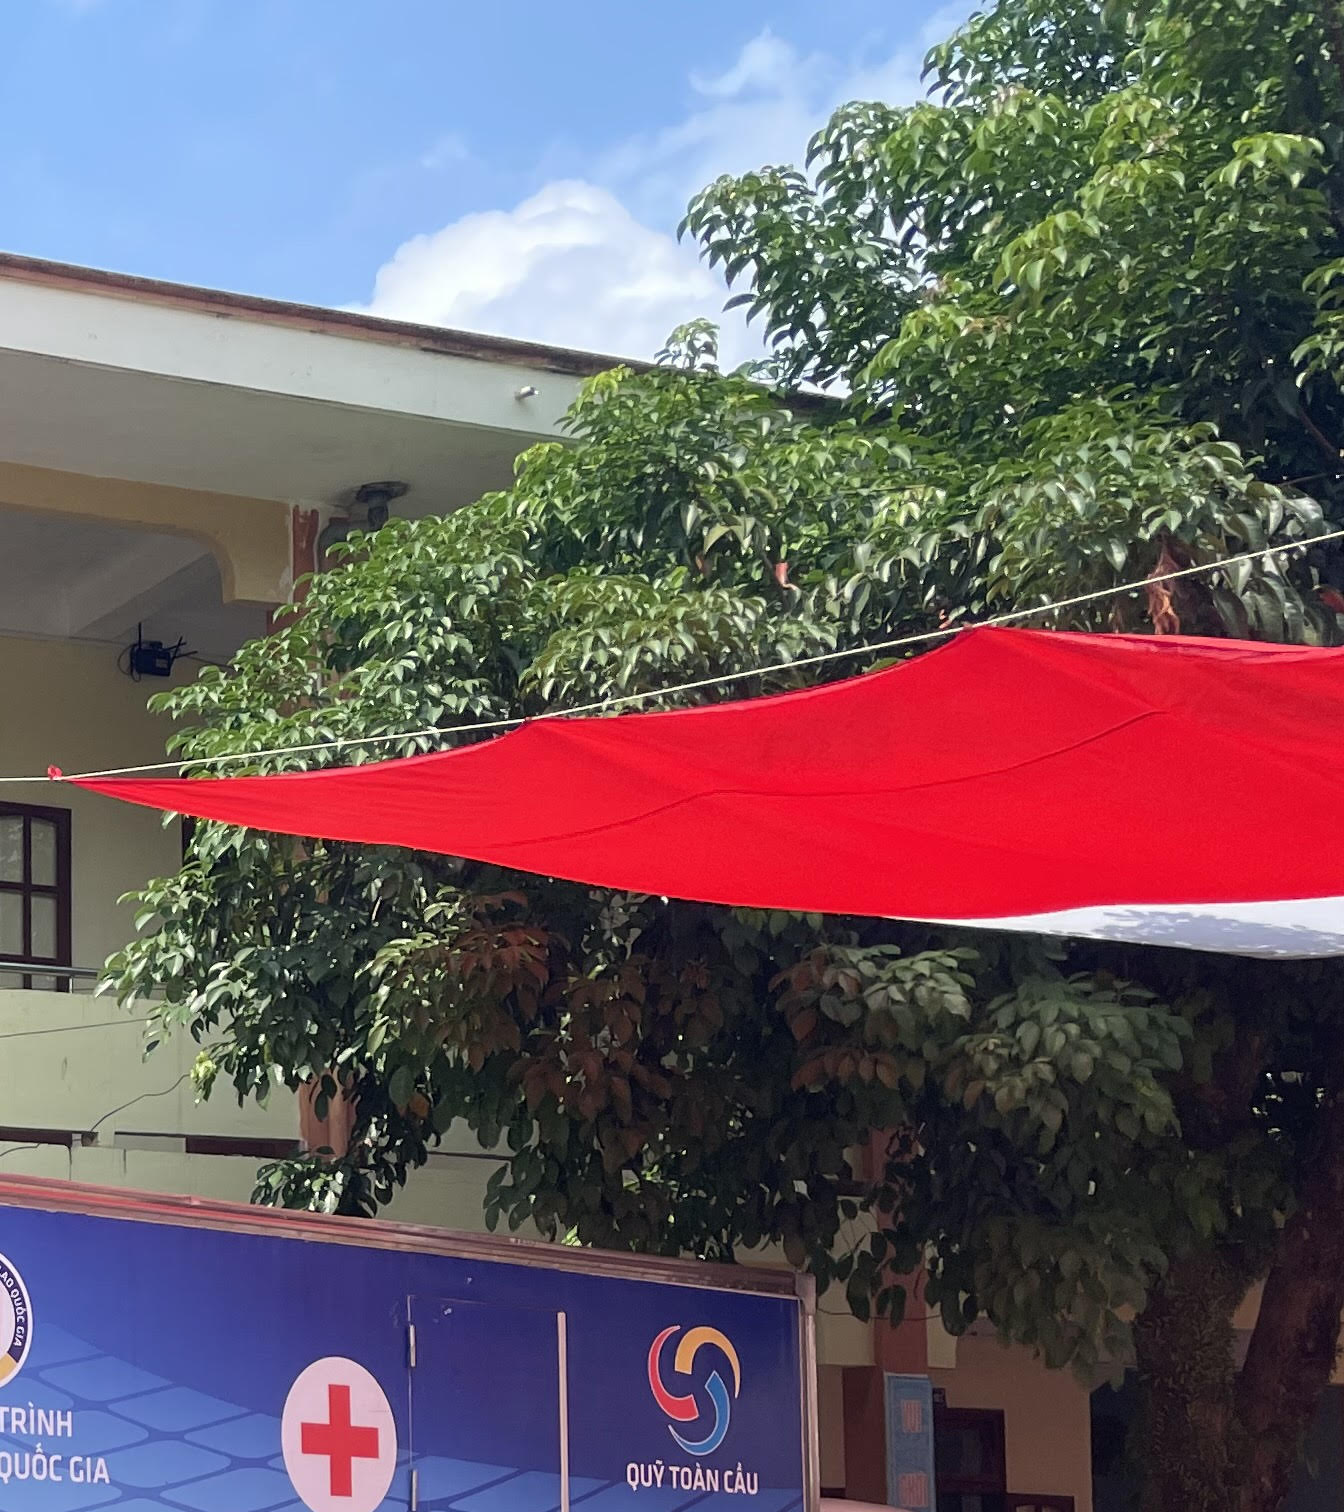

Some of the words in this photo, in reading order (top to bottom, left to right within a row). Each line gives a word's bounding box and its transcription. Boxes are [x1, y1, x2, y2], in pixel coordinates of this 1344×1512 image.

[10, 1288, 27, 1323] QUỐC
[13, 1325, 25, 1347] GIA
[69, 1455, 111, 1484] GIA
[626, 1459, 665, 1492] QUỸ
[668, 1462, 720, 1493] TOÀN
[723, 1461, 759, 1496] CẦU
